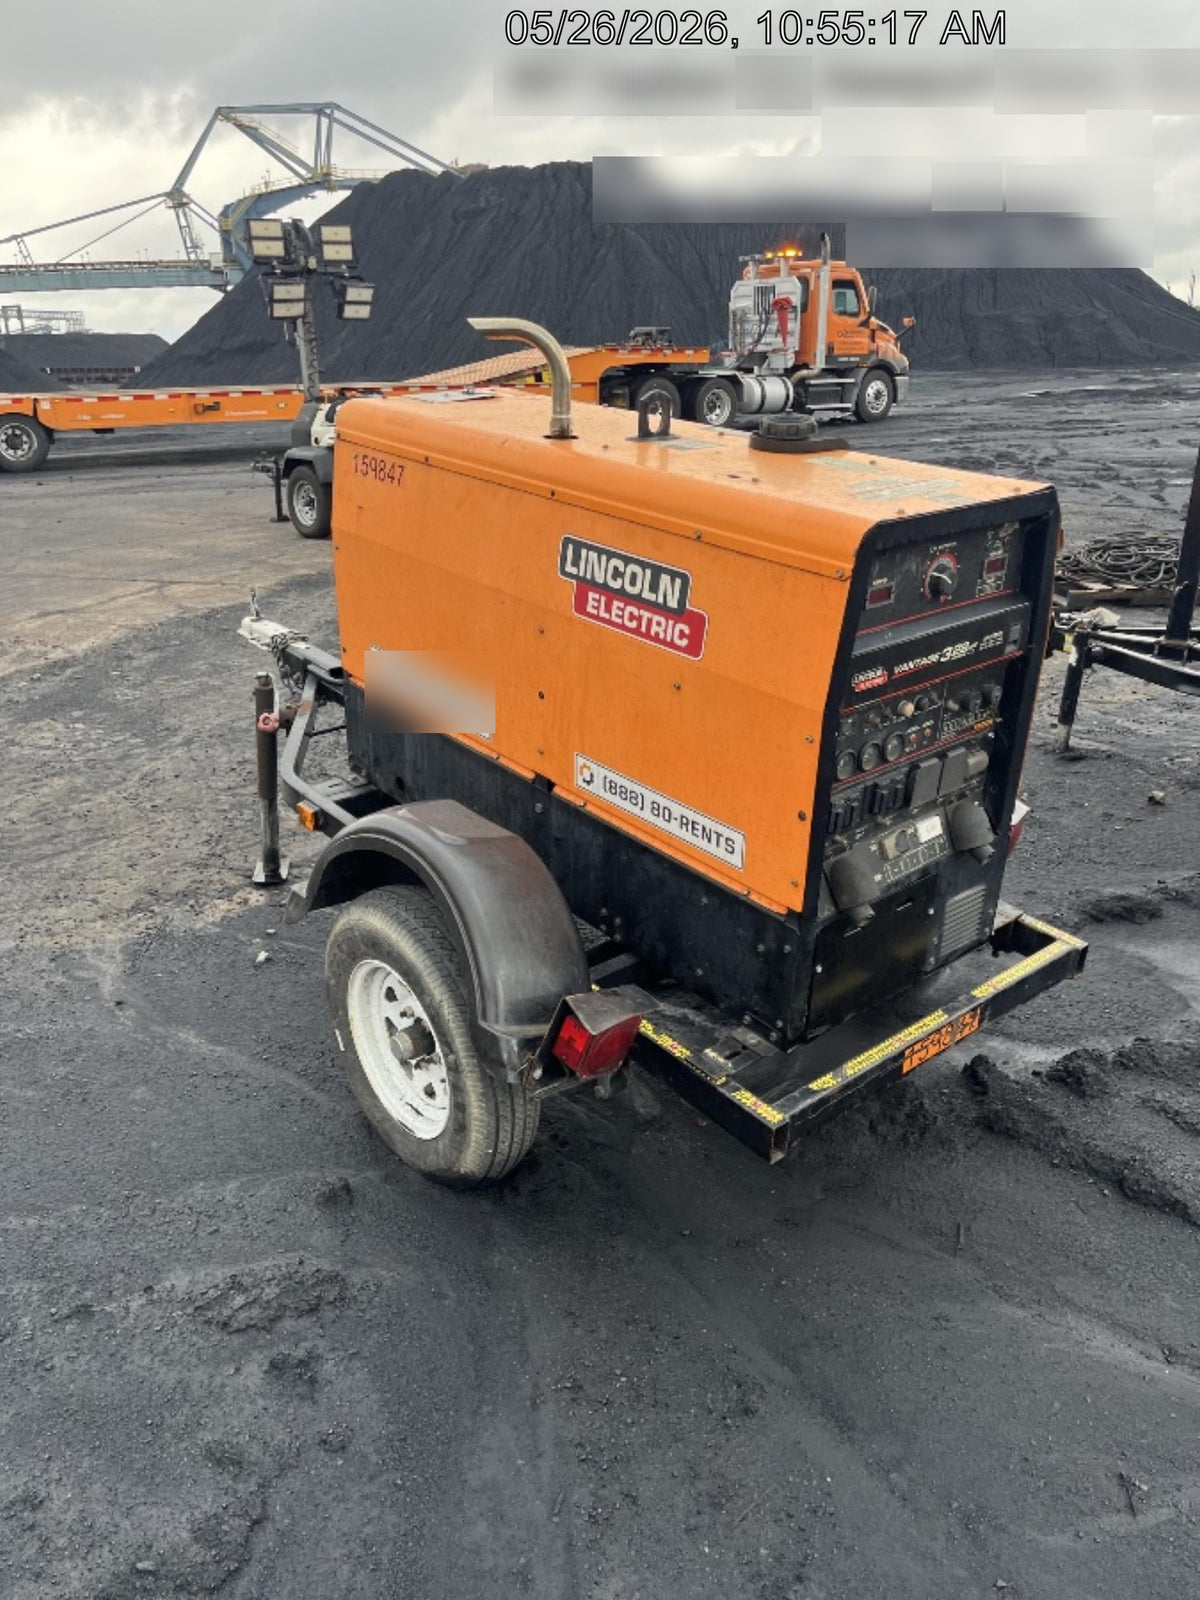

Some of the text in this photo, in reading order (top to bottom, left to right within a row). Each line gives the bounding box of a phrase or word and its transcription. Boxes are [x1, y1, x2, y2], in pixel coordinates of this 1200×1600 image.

[352, 454, 407, 488] 159847
[564, 543, 682, 609] LINCOLN
[585, 592, 691, 648] ELECTRIC
[602, 774, 736, 855] (888) 80-RENTS
